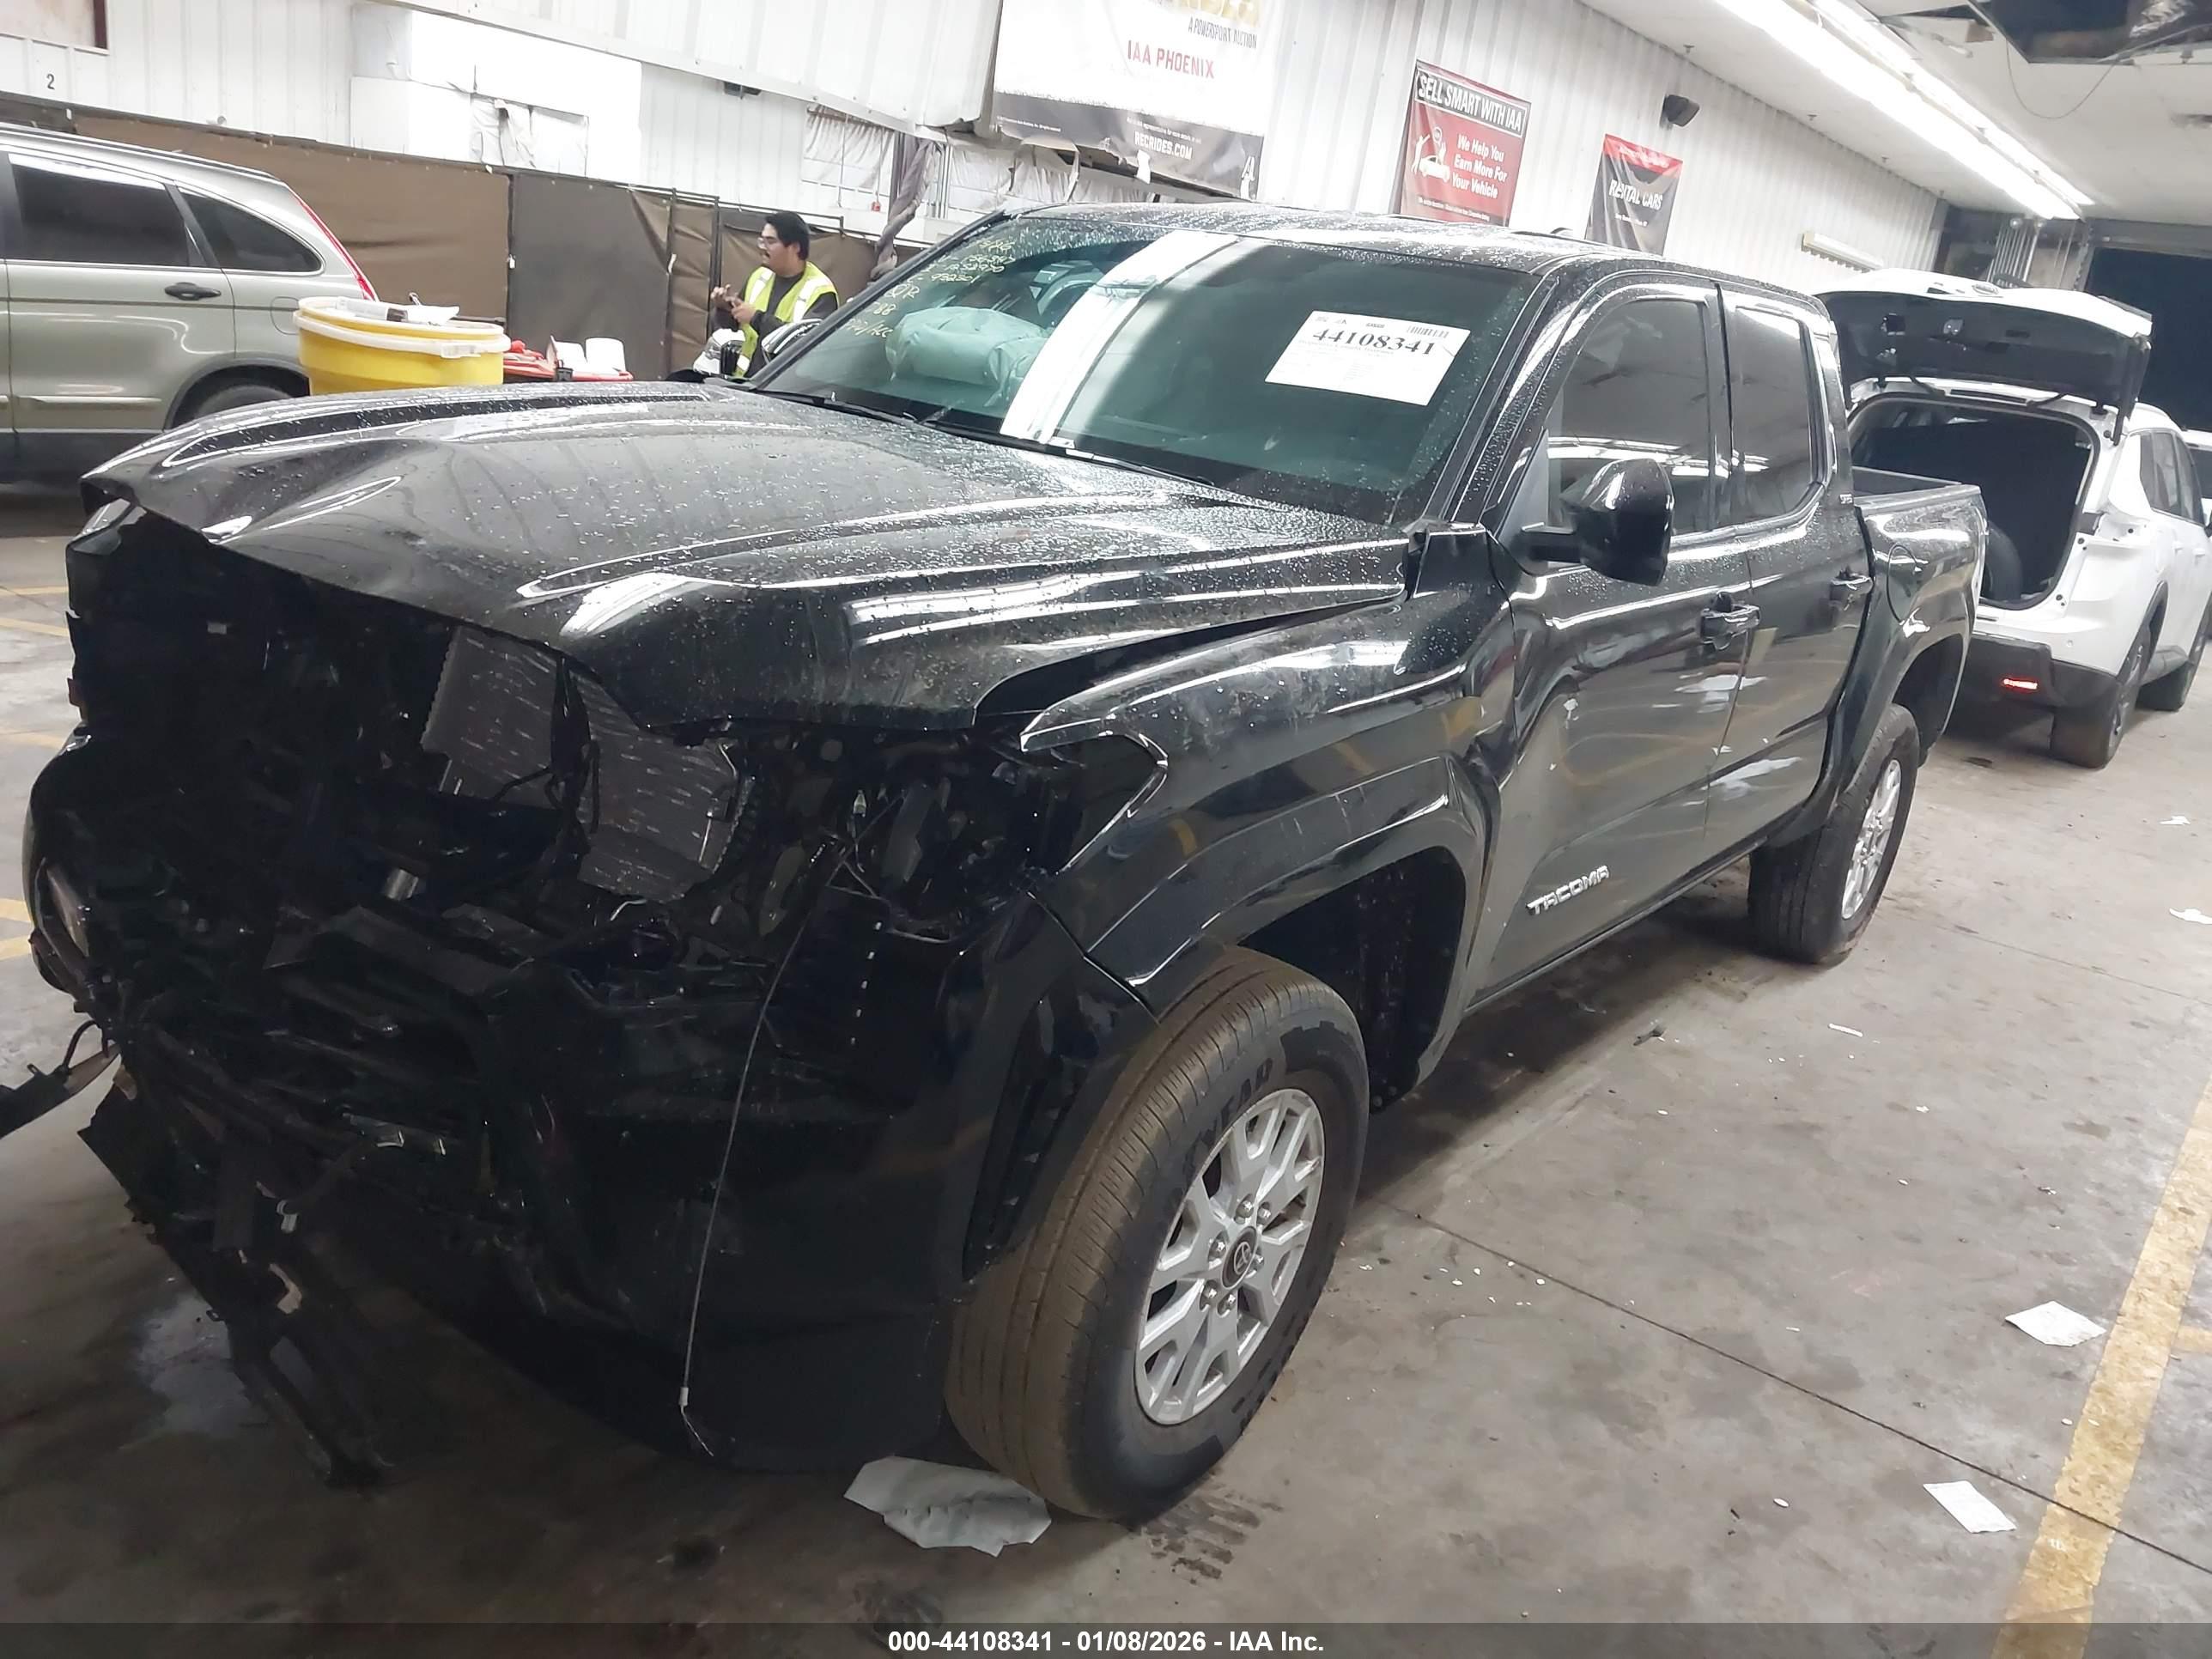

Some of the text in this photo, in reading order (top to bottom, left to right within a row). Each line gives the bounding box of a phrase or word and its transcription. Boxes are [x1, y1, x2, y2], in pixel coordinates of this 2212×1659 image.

[1188, 16, 1194, 33] A
[1194, 19, 1231, 42] POWERSPORT
[1127, 40, 1214, 79] IAA PHOENIX
[46, 73, 56, 90] 2
[1419, 75, 1522, 132] SELL SMART WITH IAA
[1134, 131, 1193, 161] RECRIDES.COM
[1457, 133, 1504, 162] We Help You
[1454, 154, 1472, 173] Earn
[1494, 166, 1507, 182] For
[1452, 172, 1498, 199] Your Vehicle
[1608, 179, 1663, 210] RENTAL CARS
[1313, 328, 1436, 356] 44108341
[1527, 865, 1609, 915] TACOMA
